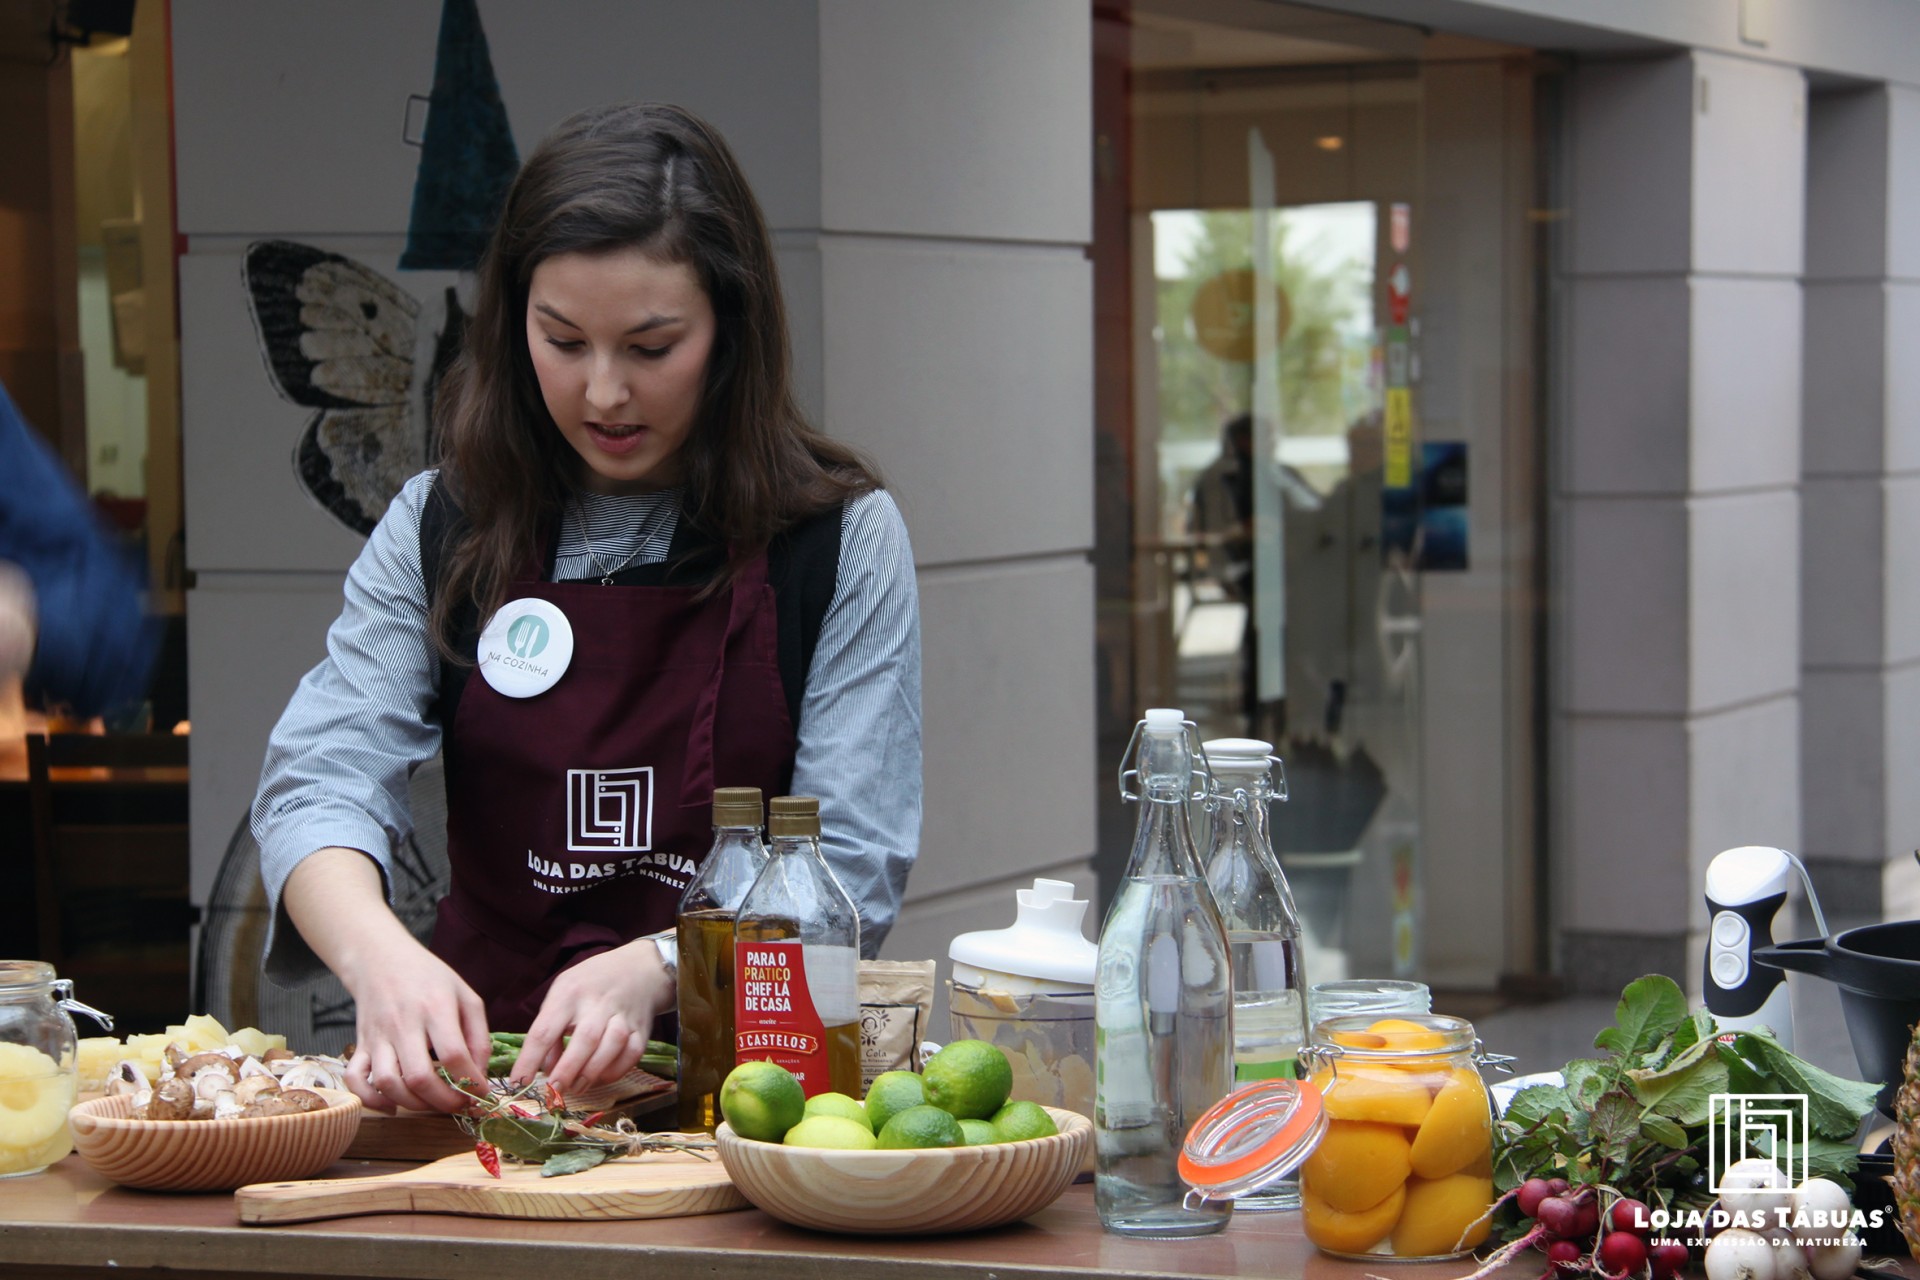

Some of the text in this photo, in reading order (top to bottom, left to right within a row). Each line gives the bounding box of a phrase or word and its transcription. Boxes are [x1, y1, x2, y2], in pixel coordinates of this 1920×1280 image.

[488, 651, 549, 678] NA COZINHA
[528, 849, 698, 879] LOJA DAS TABUA
[533, 879, 548, 892] UMA
[639, 869, 685, 890] NATUREZ
[747, 951, 787, 967] PARA O
[745, 981, 772, 996] CHEF
[745, 997, 792, 1012] DE CASA
[738, 1033, 807, 1050] 3 CASTELOS
